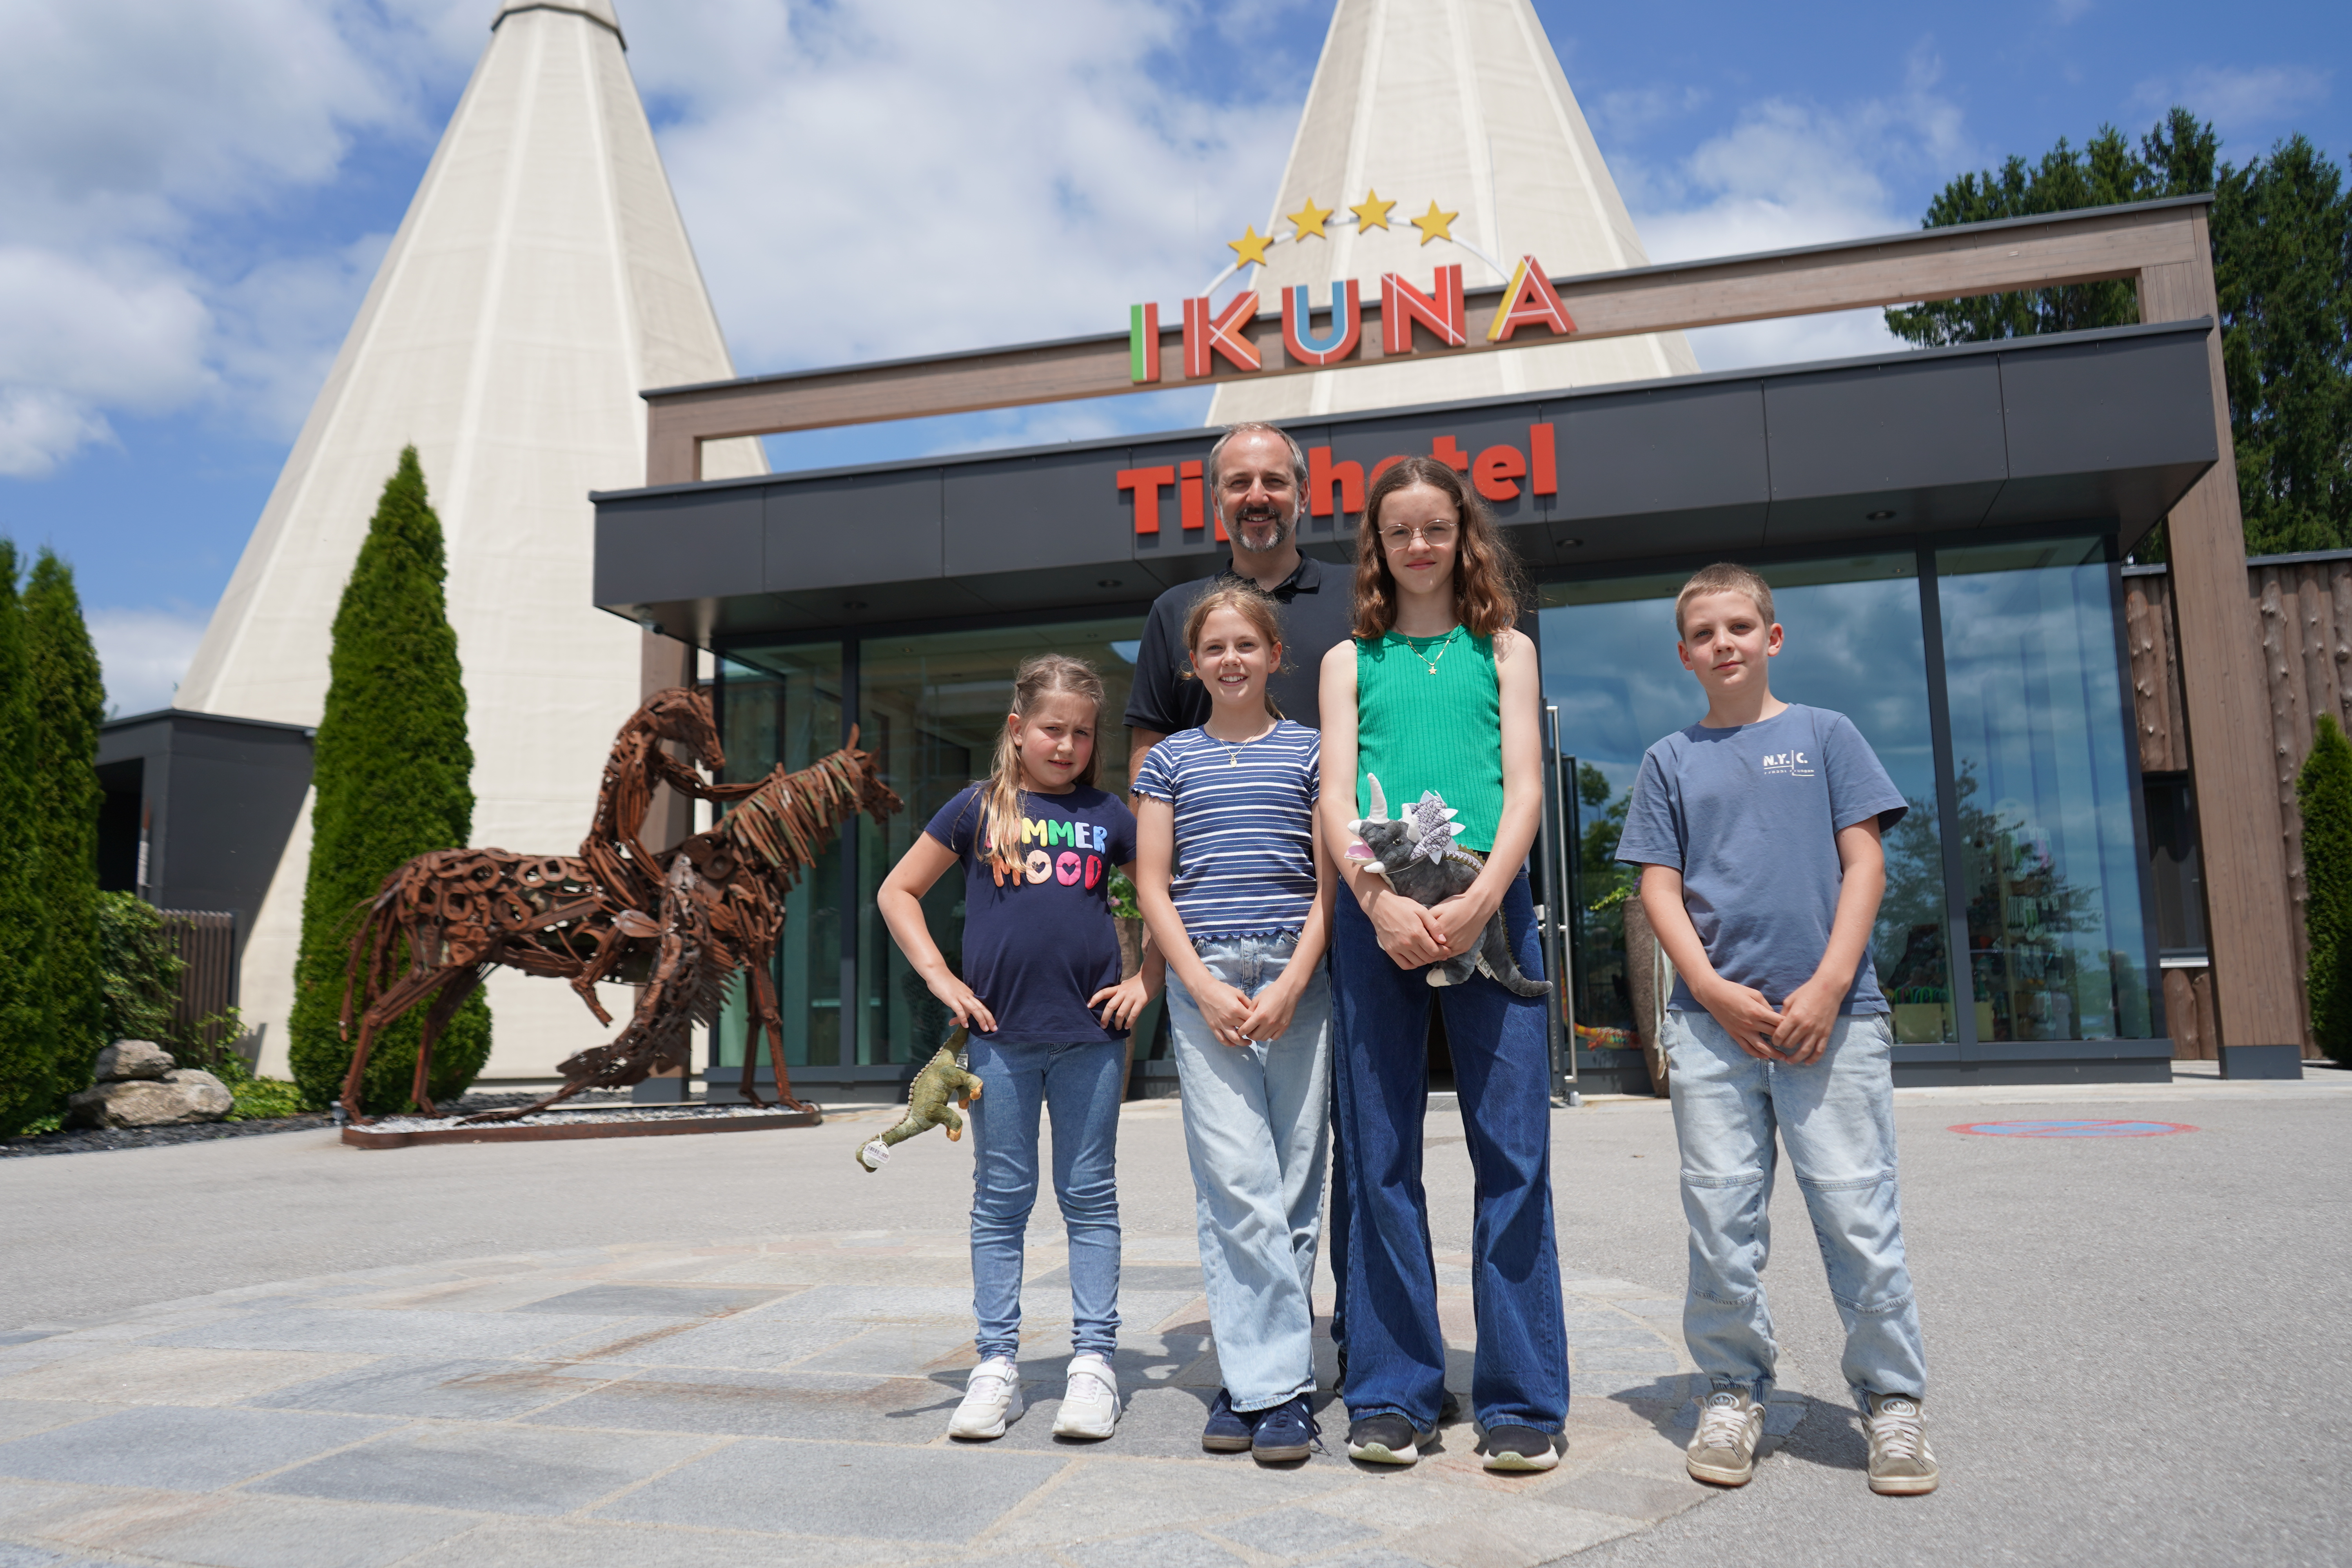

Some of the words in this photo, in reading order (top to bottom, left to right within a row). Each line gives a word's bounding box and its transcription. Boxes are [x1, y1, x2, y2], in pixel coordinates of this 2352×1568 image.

[1131, 255, 1577, 383] IKUNA
[1117, 423, 1557, 541] Tihtel
[985, 817, 1108, 855] MMER
